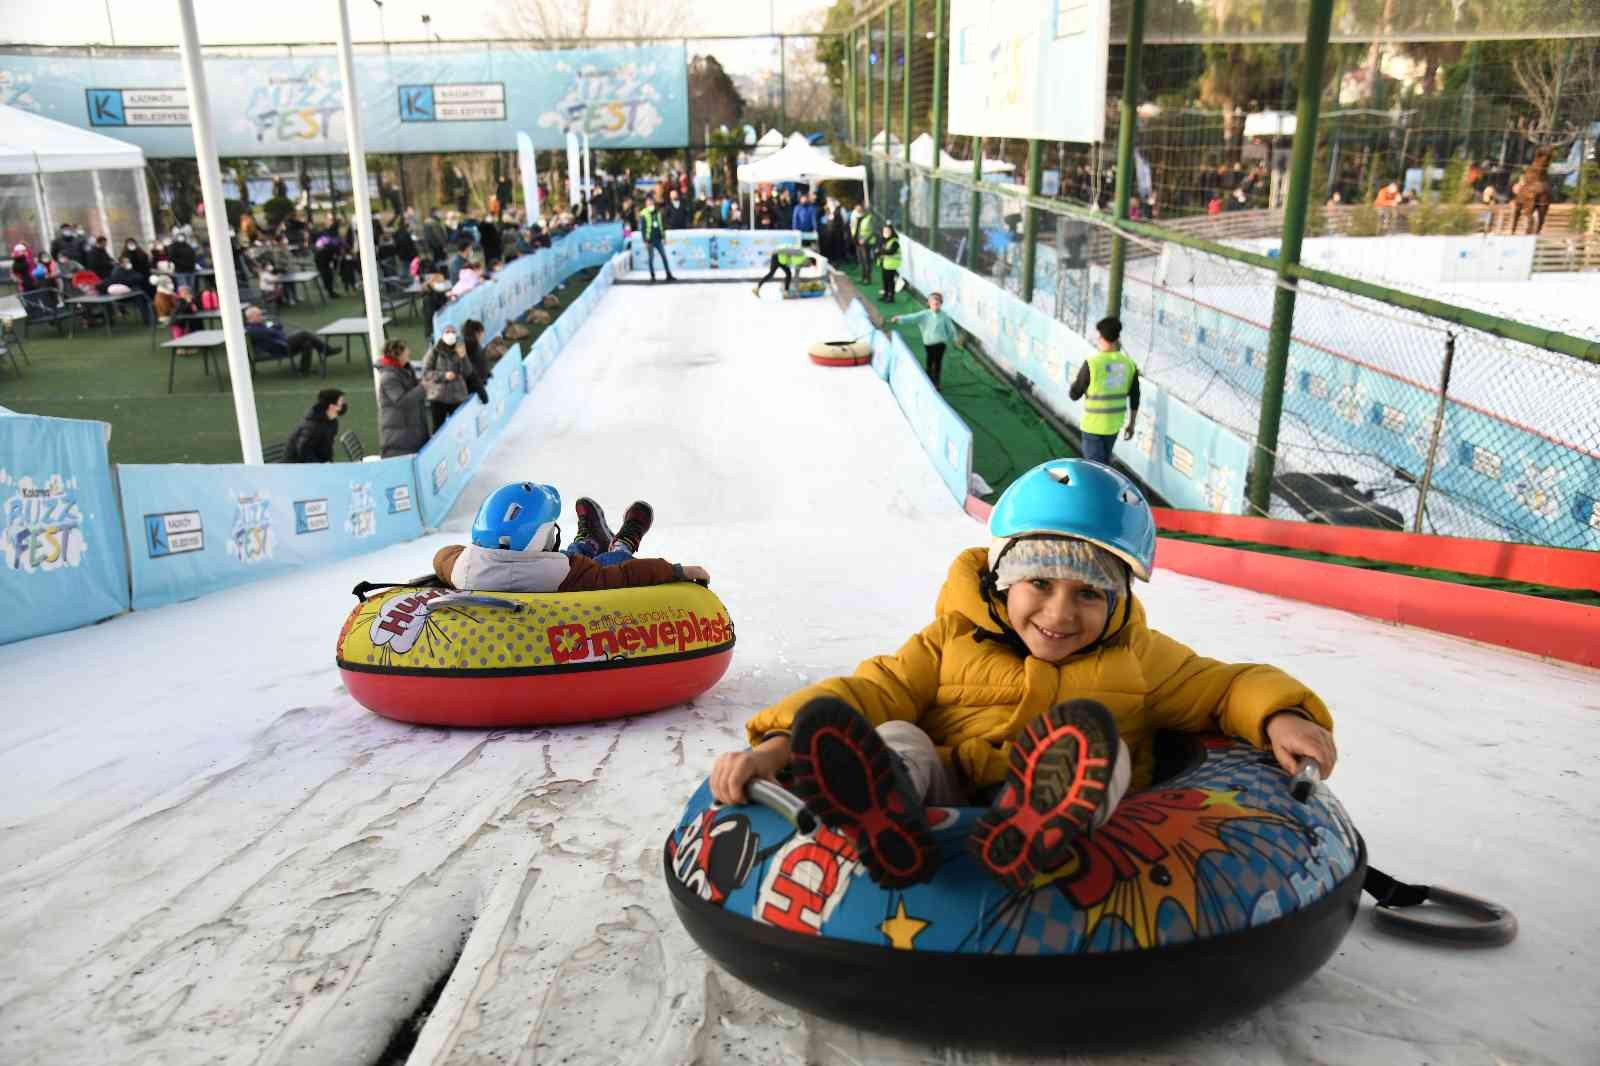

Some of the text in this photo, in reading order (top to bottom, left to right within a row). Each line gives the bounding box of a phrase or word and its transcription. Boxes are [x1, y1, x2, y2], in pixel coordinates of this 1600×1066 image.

[95, 95, 122, 119] K
[256, 107, 344, 142] FEST
[14, 524, 79, 570] FEST
[149, 522, 168, 551] K
[234, 523, 272, 561] FEST
[591, 611, 732, 657] neveplast
